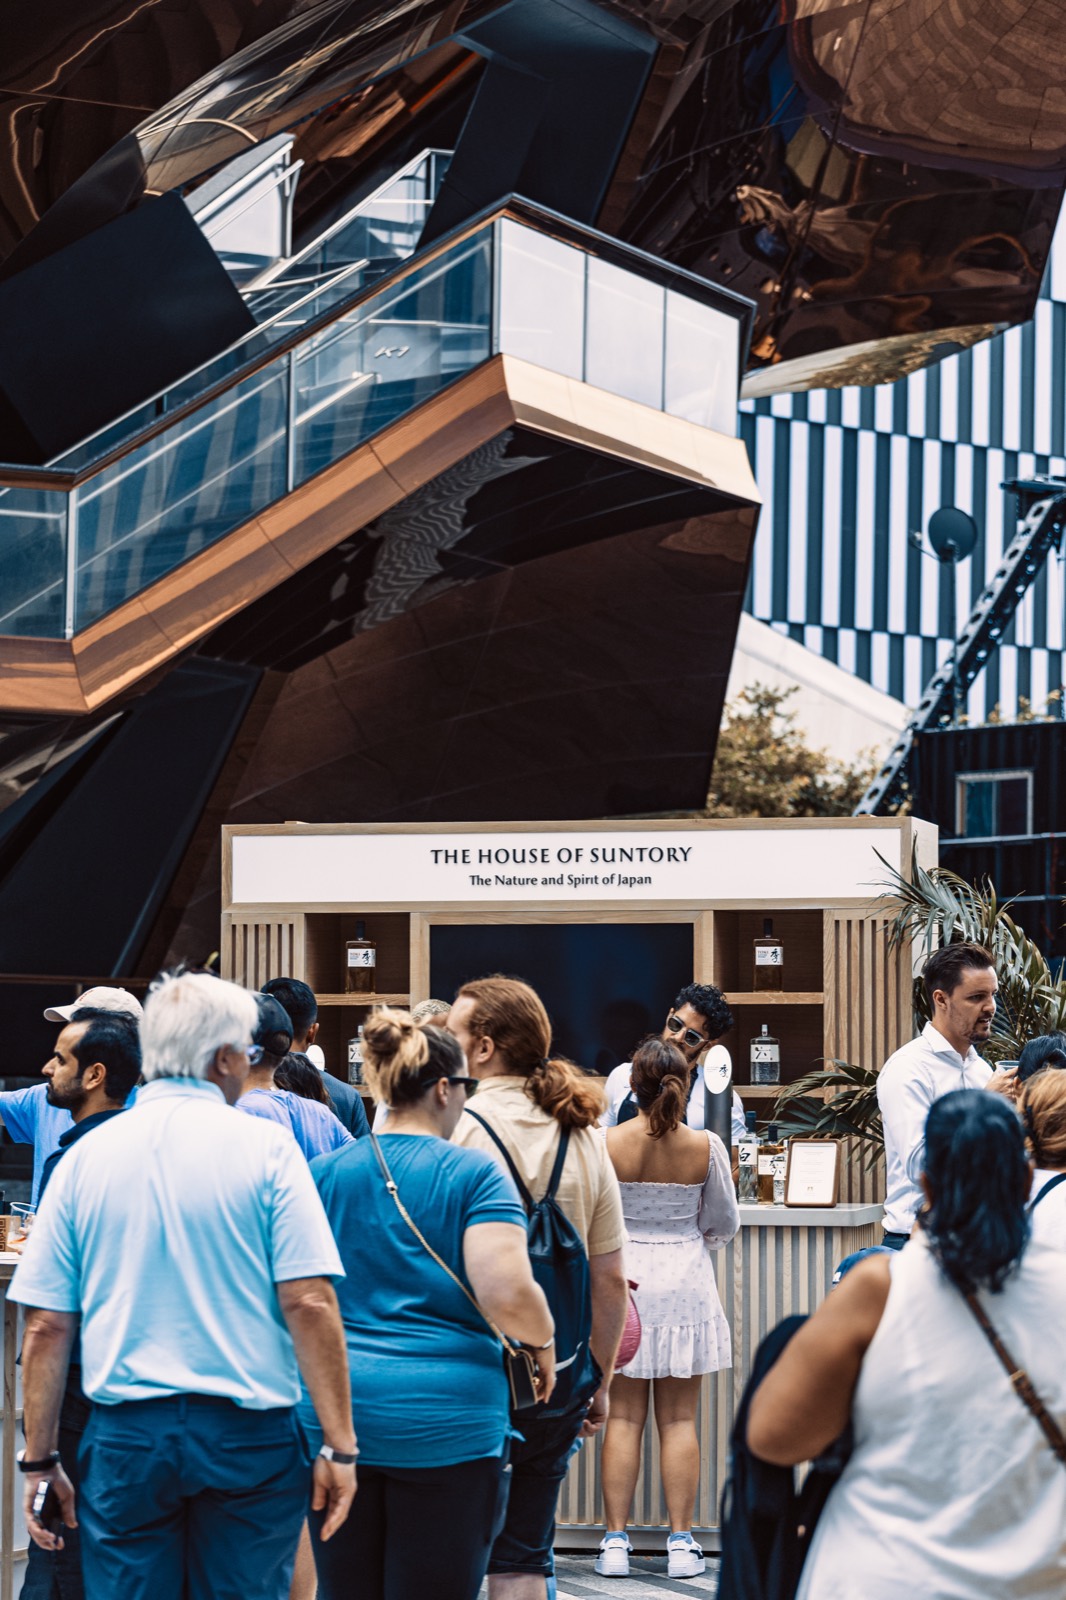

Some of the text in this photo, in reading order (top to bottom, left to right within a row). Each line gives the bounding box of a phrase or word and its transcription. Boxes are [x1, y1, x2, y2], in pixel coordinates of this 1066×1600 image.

[430, 847, 692, 864] THE HOUSE OF SUNTORY
[469, 873, 652, 888] The Nature and Spirit of Japan
